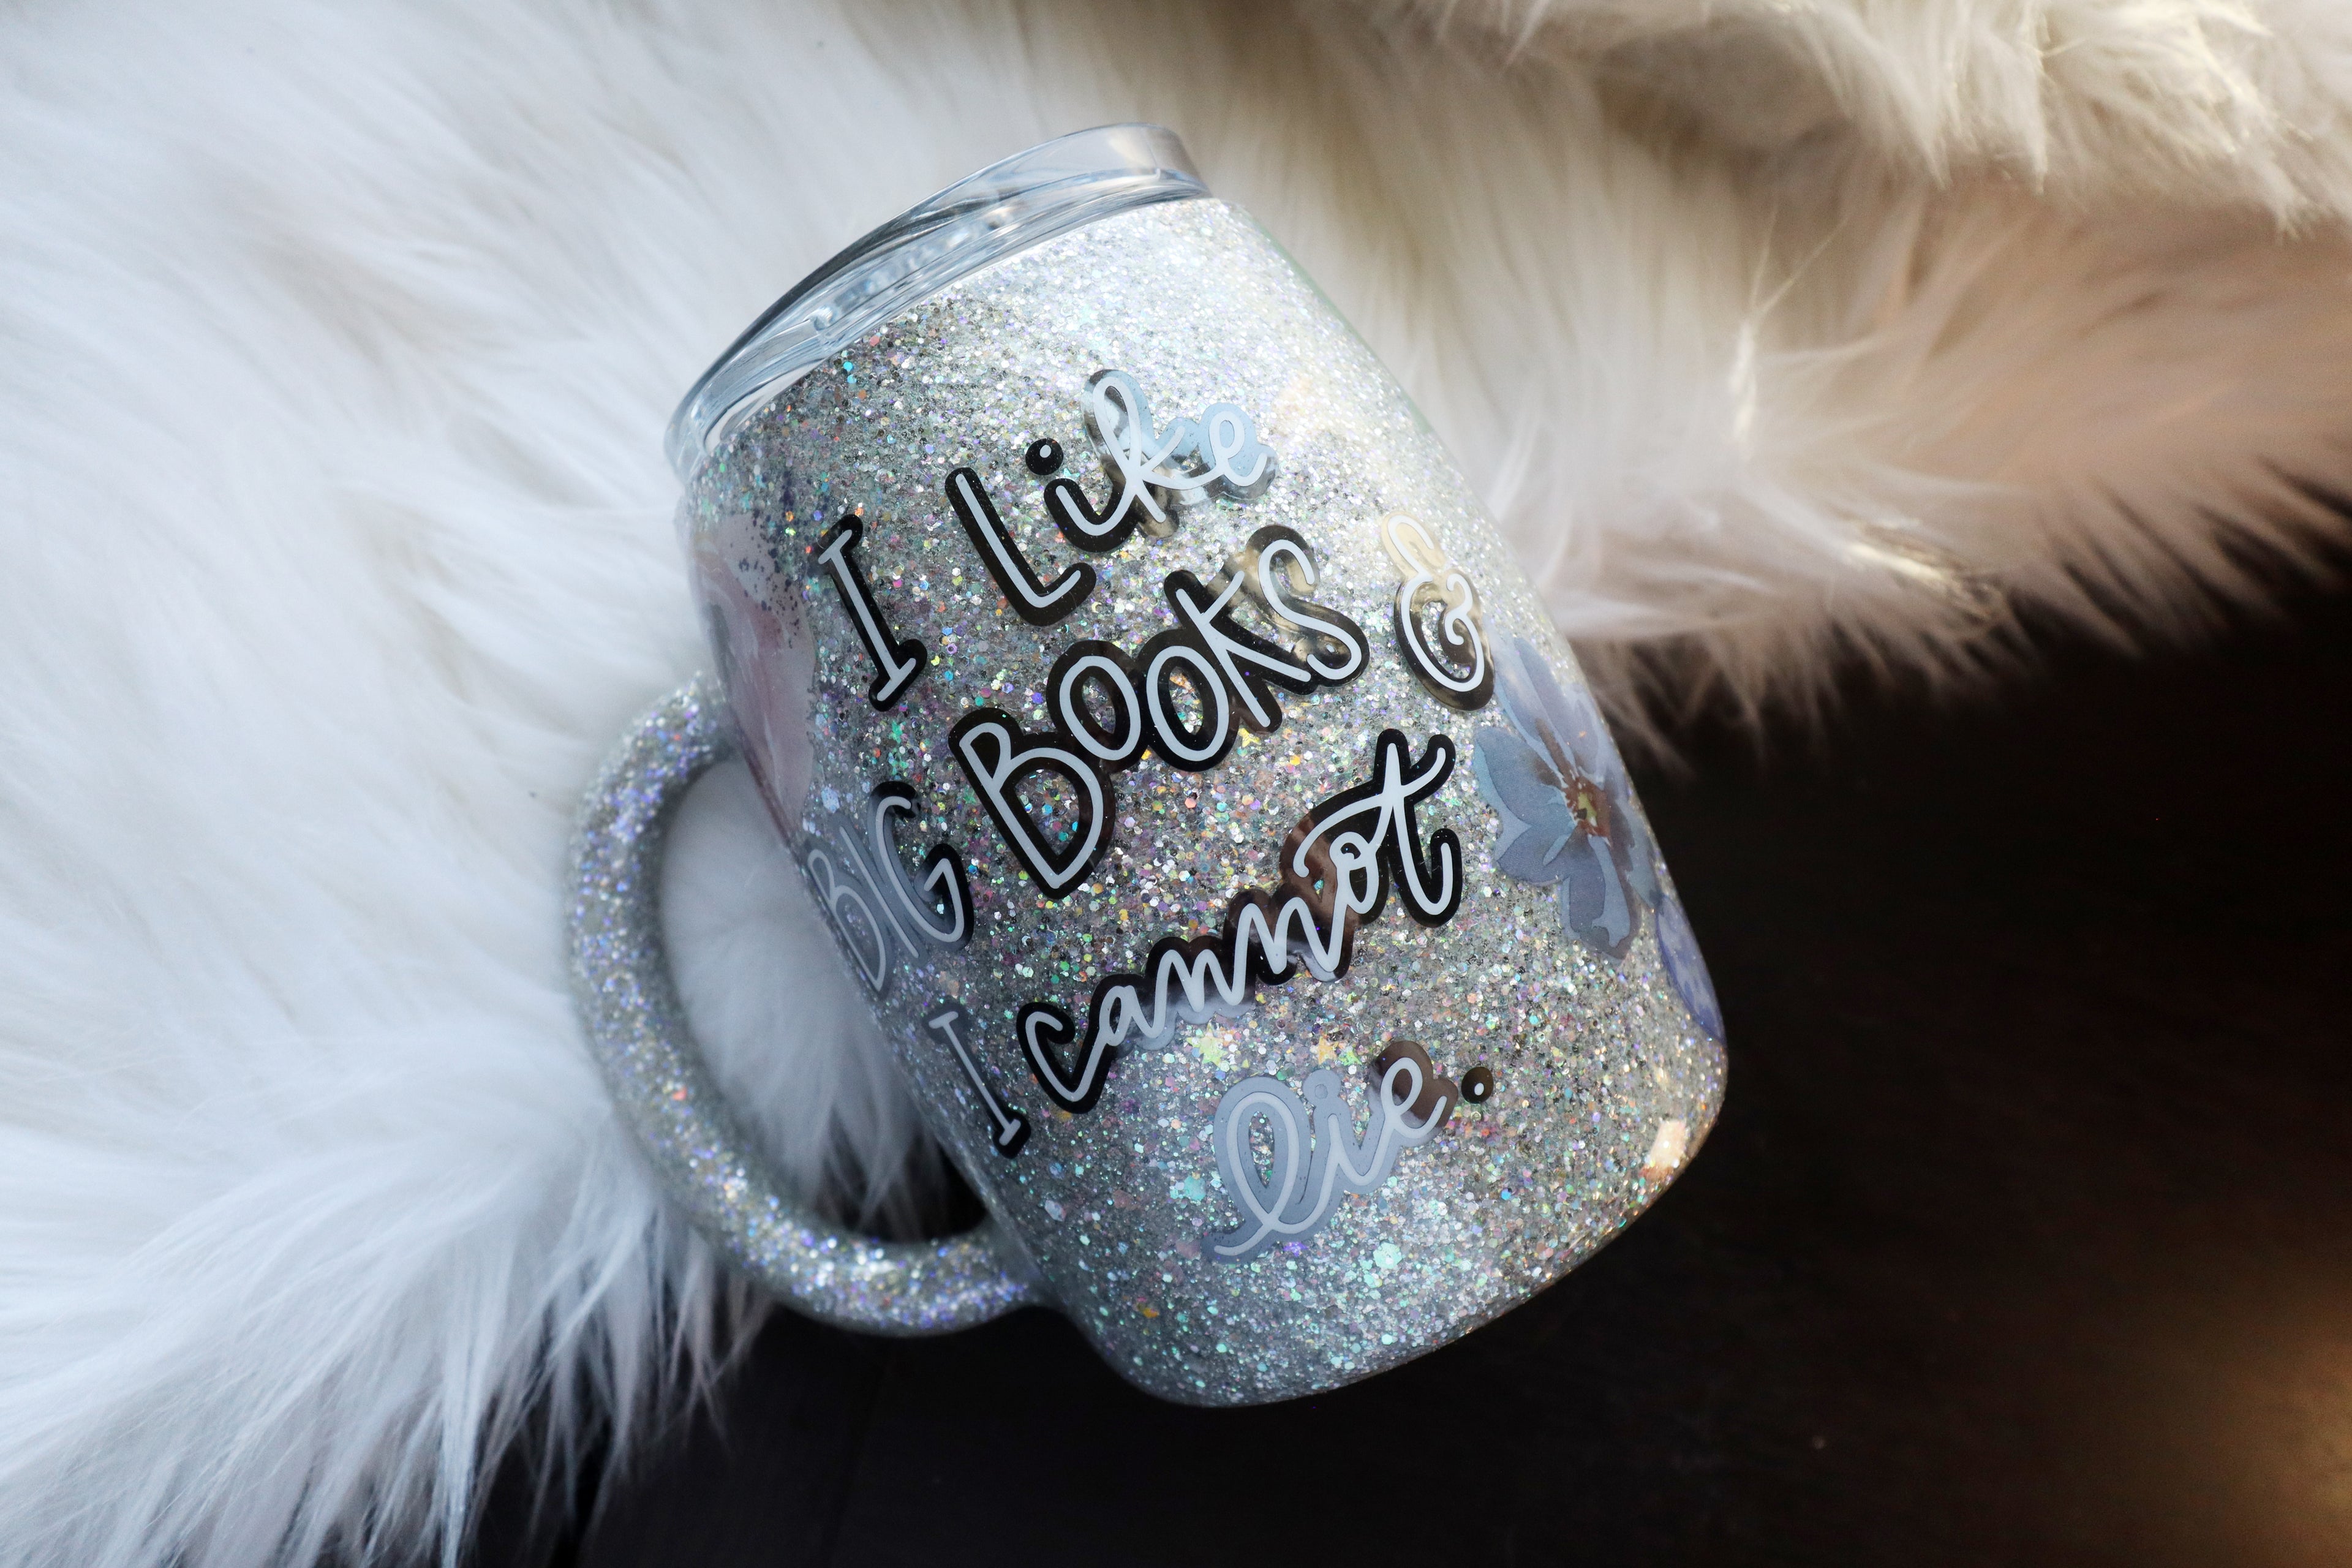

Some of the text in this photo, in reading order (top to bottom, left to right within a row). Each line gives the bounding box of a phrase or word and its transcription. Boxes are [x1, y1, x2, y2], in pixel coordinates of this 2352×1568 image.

[816, 369, 1276, 712] I Like
[799, 511, 1495, 999] BIG BOOKS &
[926, 729, 1462, 1159] I cannot
[1202, 1041, 1493, 1261] lie.
